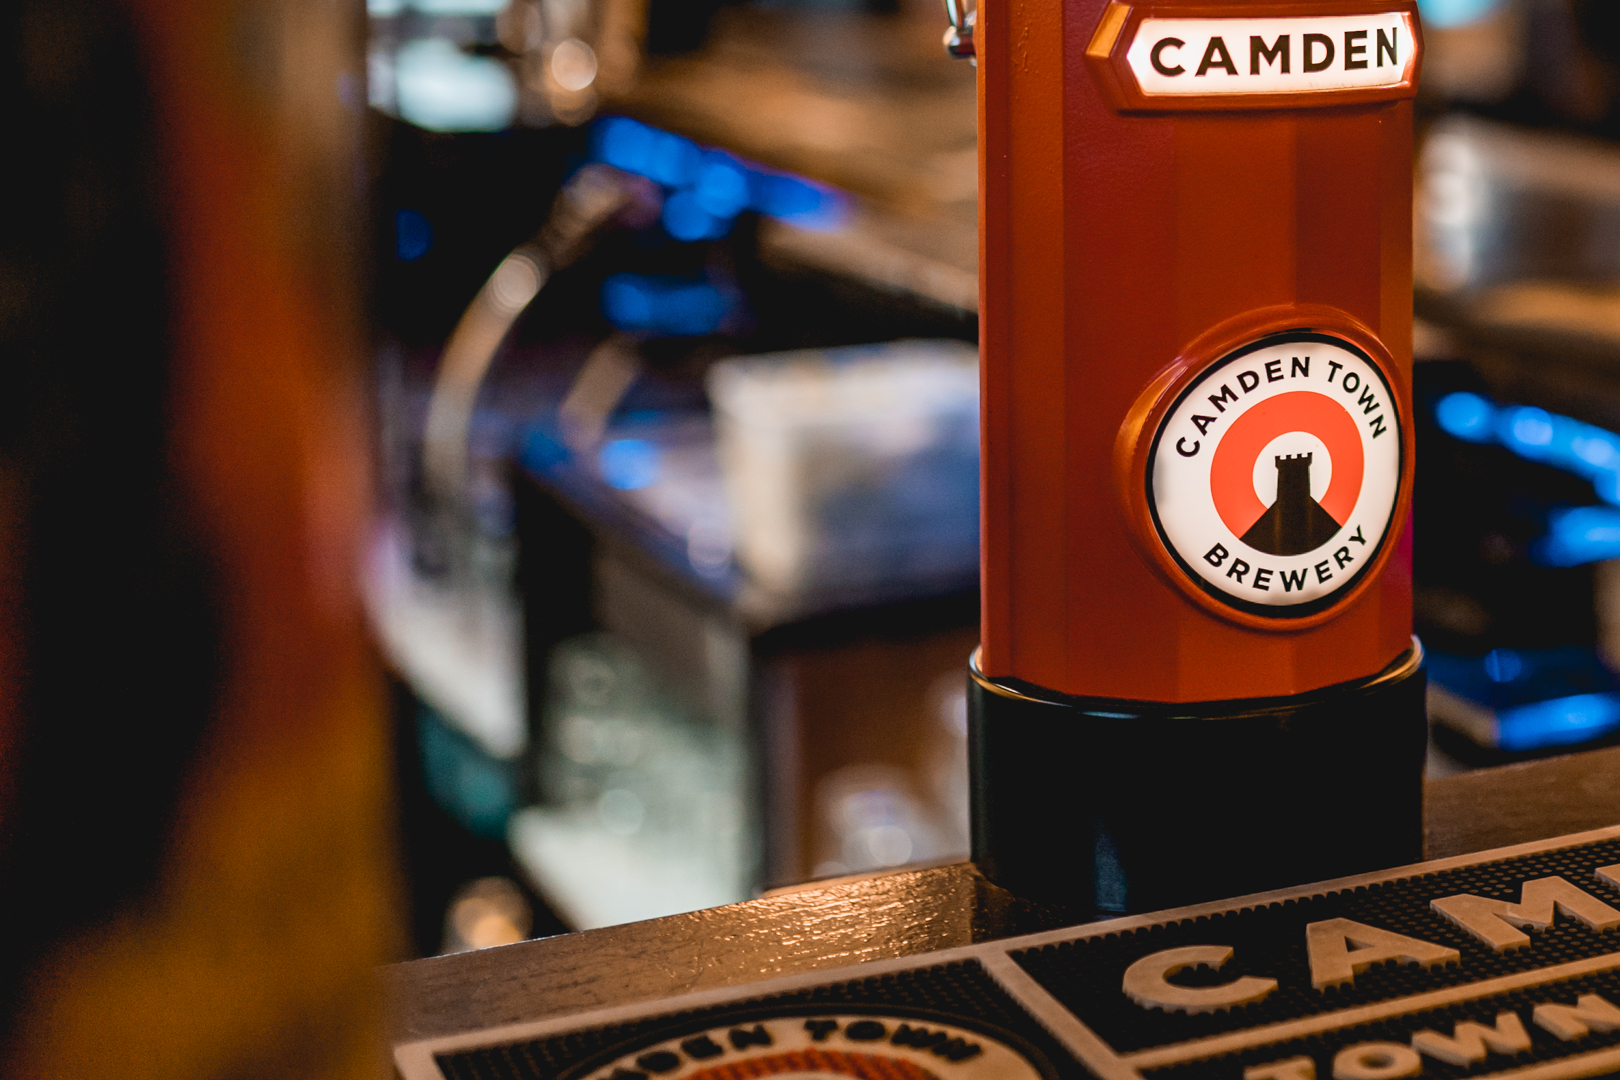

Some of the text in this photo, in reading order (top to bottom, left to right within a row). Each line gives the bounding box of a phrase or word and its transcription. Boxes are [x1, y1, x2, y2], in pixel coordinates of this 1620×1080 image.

[1150, 26, 1399, 77] CAMDEN
[1175, 356, 1388, 458] CAMDEN TOWN
[1202, 524, 1368, 593] BREWERY
